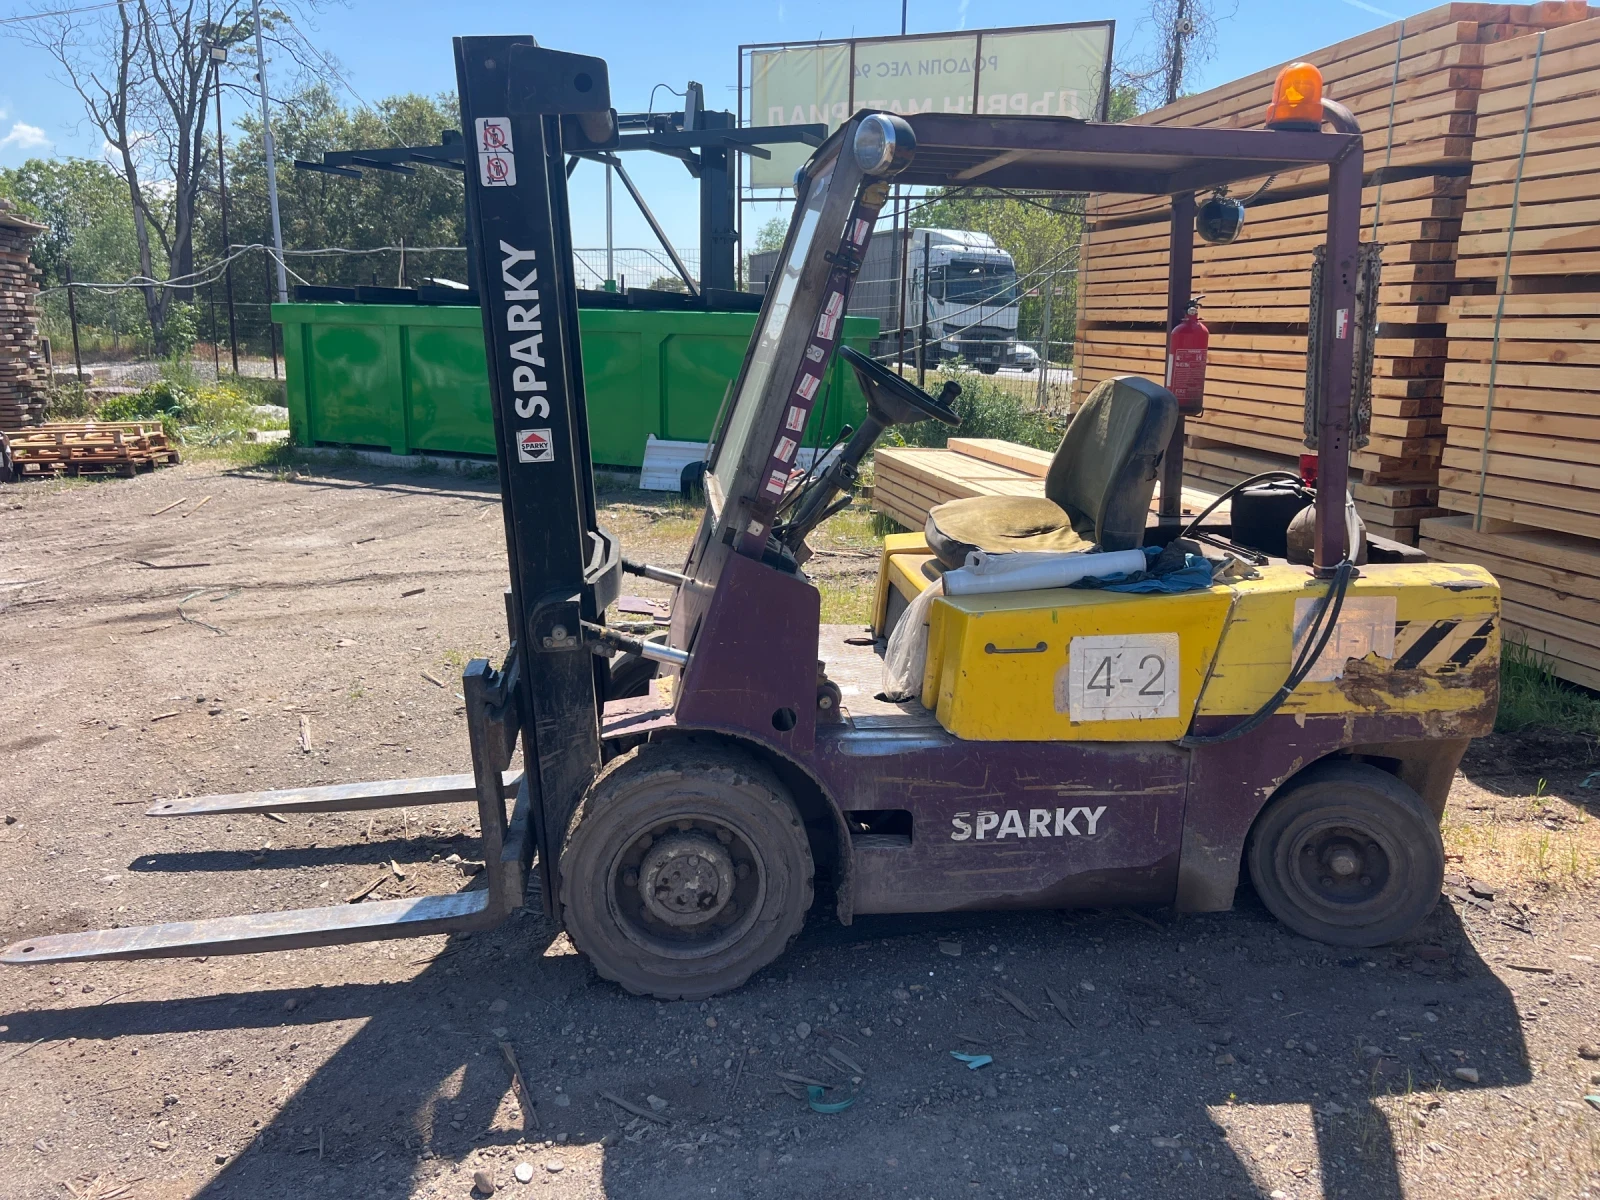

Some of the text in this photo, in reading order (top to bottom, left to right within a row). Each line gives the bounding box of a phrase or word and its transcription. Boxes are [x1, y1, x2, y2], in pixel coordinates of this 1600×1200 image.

[499, 239, 550, 419] SPARKY
[521, 442, 548, 450] SPARKY
[1087, 654, 1165, 697] 4-2
[951, 806, 1107, 841] SPARKY
